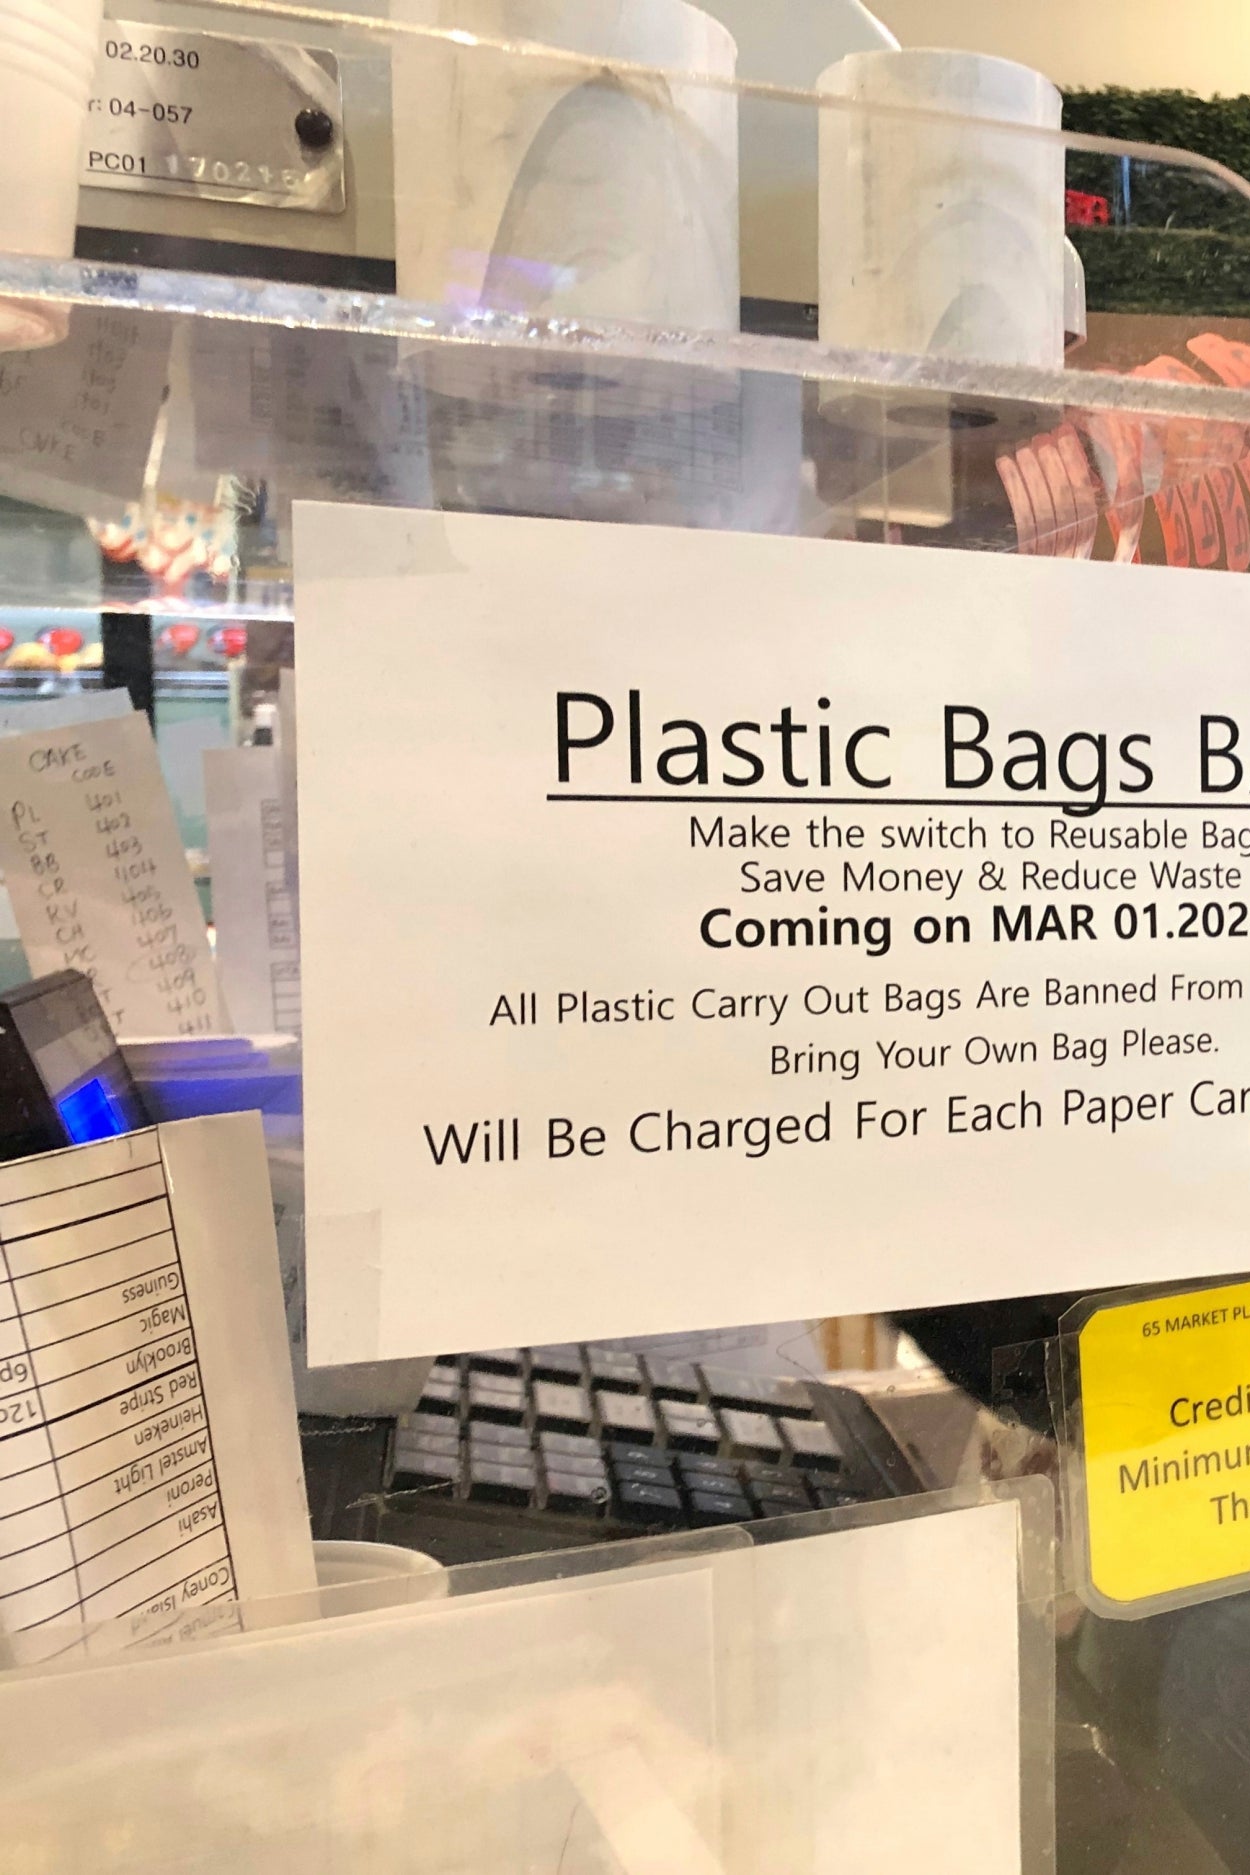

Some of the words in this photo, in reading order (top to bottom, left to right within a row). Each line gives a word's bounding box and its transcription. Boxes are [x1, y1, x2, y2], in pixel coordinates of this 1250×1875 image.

[105, 40, 200, 69] 02.20.30
[109, 98, 193, 124] 04-057
[88, 150, 146, 174] PC01
[29, 743, 87, 772] CAKE
[557, 689, 891, 788] Plastic
[942, 703, 1155, 817] Bags
[85, 790, 122, 811] 401
[97, 812, 131, 834] 402
[691, 815, 790, 848] Make
[806, 816, 865, 848] the
[881, 817, 986, 848] switch
[1002, 822, 1034, 849] to
[1051, 819, 1187, 849] Reusable
[105, 836, 143, 858] 403
[741, 861, 825, 893] Save
[844, 862, 963, 900] Money
[979, 861, 1006, 891] &
[1023, 860, 1136, 890] Reduce
[1150, 861, 1241, 889] Waste
[700, 905, 891, 957] Coming
[914, 916, 970, 944] on
[993, 904, 1097, 942] MAR
[489, 992, 536, 1026] All
[558, 989, 674, 1024] Plastic
[692, 988, 788, 1026] Carry
[804, 985, 869, 1015] Out
[885, 983, 961, 1019] Bags
[976, 980, 1029, 1009] Are
[1046, 974, 1156, 1006] Banned
[1172, 974, 1242, 1001] From
[771, 1043, 859, 1080] Bring
[876, 1041, 951, 1069] Your
[965, 1036, 1037, 1065] Own
[1053, 1033, 1107, 1067] Bag
[1123, 1028, 1219, 1057] Please.
[423, 1118, 518, 1165] Will
[549, 1118, 606, 1158] Be
[630, 1101, 830, 1158] Charged
[857, 1101, 927, 1139] For
[948, 1090, 1041, 1133] Each
[1064, 1089, 1174, 1133] Paper
[122, 1271, 180, 1304] Guiness
[140, 1304, 186, 1334] Magic
[1141, 1320, 1161, 1338] 65
[1164, 1308, 1230, 1333] MARKET
[126, 1337, 192, 1375] Brooklyn
[169, 1371, 198, 1394] Red
[120, 1385, 164, 1416] Stripe
[134, 1403, 204, 1446] Heineken
[159, 1436, 208, 1476] Amstel
[113, 1465, 154, 1495] Light
[166, 1468, 213, 1508] Peroni
[178, 1501, 218, 1537] Asahi
[181, 1566, 230, 1603] Coney
